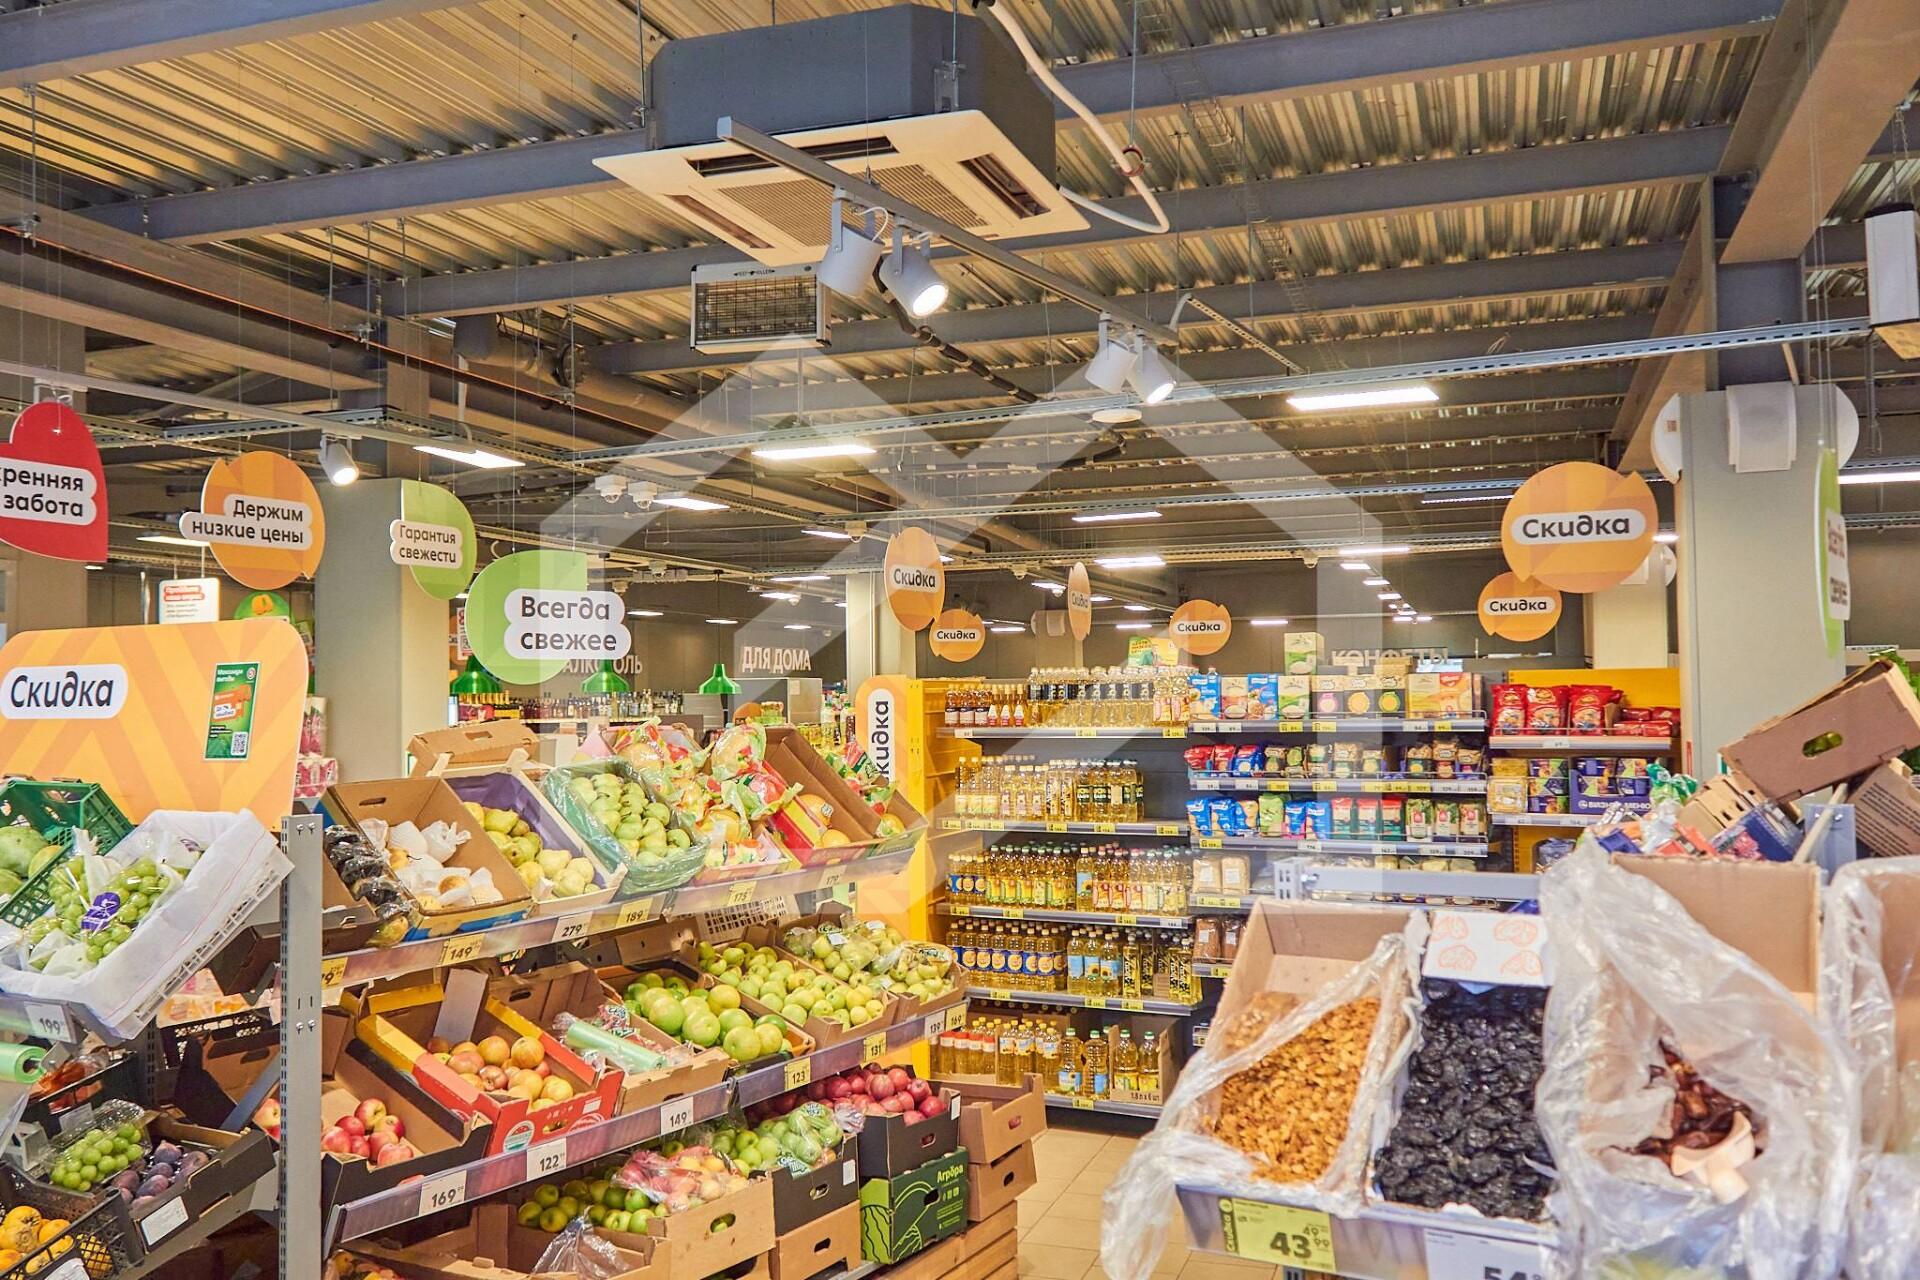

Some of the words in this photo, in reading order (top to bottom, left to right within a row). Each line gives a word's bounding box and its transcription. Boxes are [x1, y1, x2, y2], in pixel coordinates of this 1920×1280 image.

[0, 467, 83, 492] ренняя
[4, 494, 83, 517] забота
[233, 500, 303, 521] Держим
[192, 520, 255, 539] низкие
[261, 527, 304, 544] цены
[399, 525, 457, 545] Гарантия
[1522, 514, 1630, 539] Скидка
[399, 547, 457, 564] свежести
[893, 567, 936, 589] Скидка
[521, 595, 610, 621] Всегда
[1489, 599, 1547, 612] Скидка
[937, 628, 976, 641] Скидка
[1177, 621, 1221, 634] Скидка
[520, 631, 618, 652] свежее
[562, 655, 643, 675] АЛКОЛЬ
[741, 646, 771, 673] ДЛЯ
[773, 647, 812, 674] ДОМА
[10, 670, 114, 709] Скидка
[872, 701, 889, 781] кидка
[626, 910, 643, 923] 189
[561, 925, 583, 938] 279
[450, 946, 472, 960] 149
[321, 972, 335, 985] 9
[39, 1018, 61, 1035] 199
[930, 1022, 941, 1034] 139
[951, 1014, 962, 1027] 169
[871, 1045, 881, 1057] 131
[792, 1071, 806, 1085] 123
[669, 1111, 688, 1127] 149
[540, 1154, 560, 1172] 122
[432, 1188, 456, 1208] 169
[1303, 1226, 1319, 1237] 49
[1270, 1231, 1312, 1259] 43
[1313, 1238, 1330, 1247] 99
